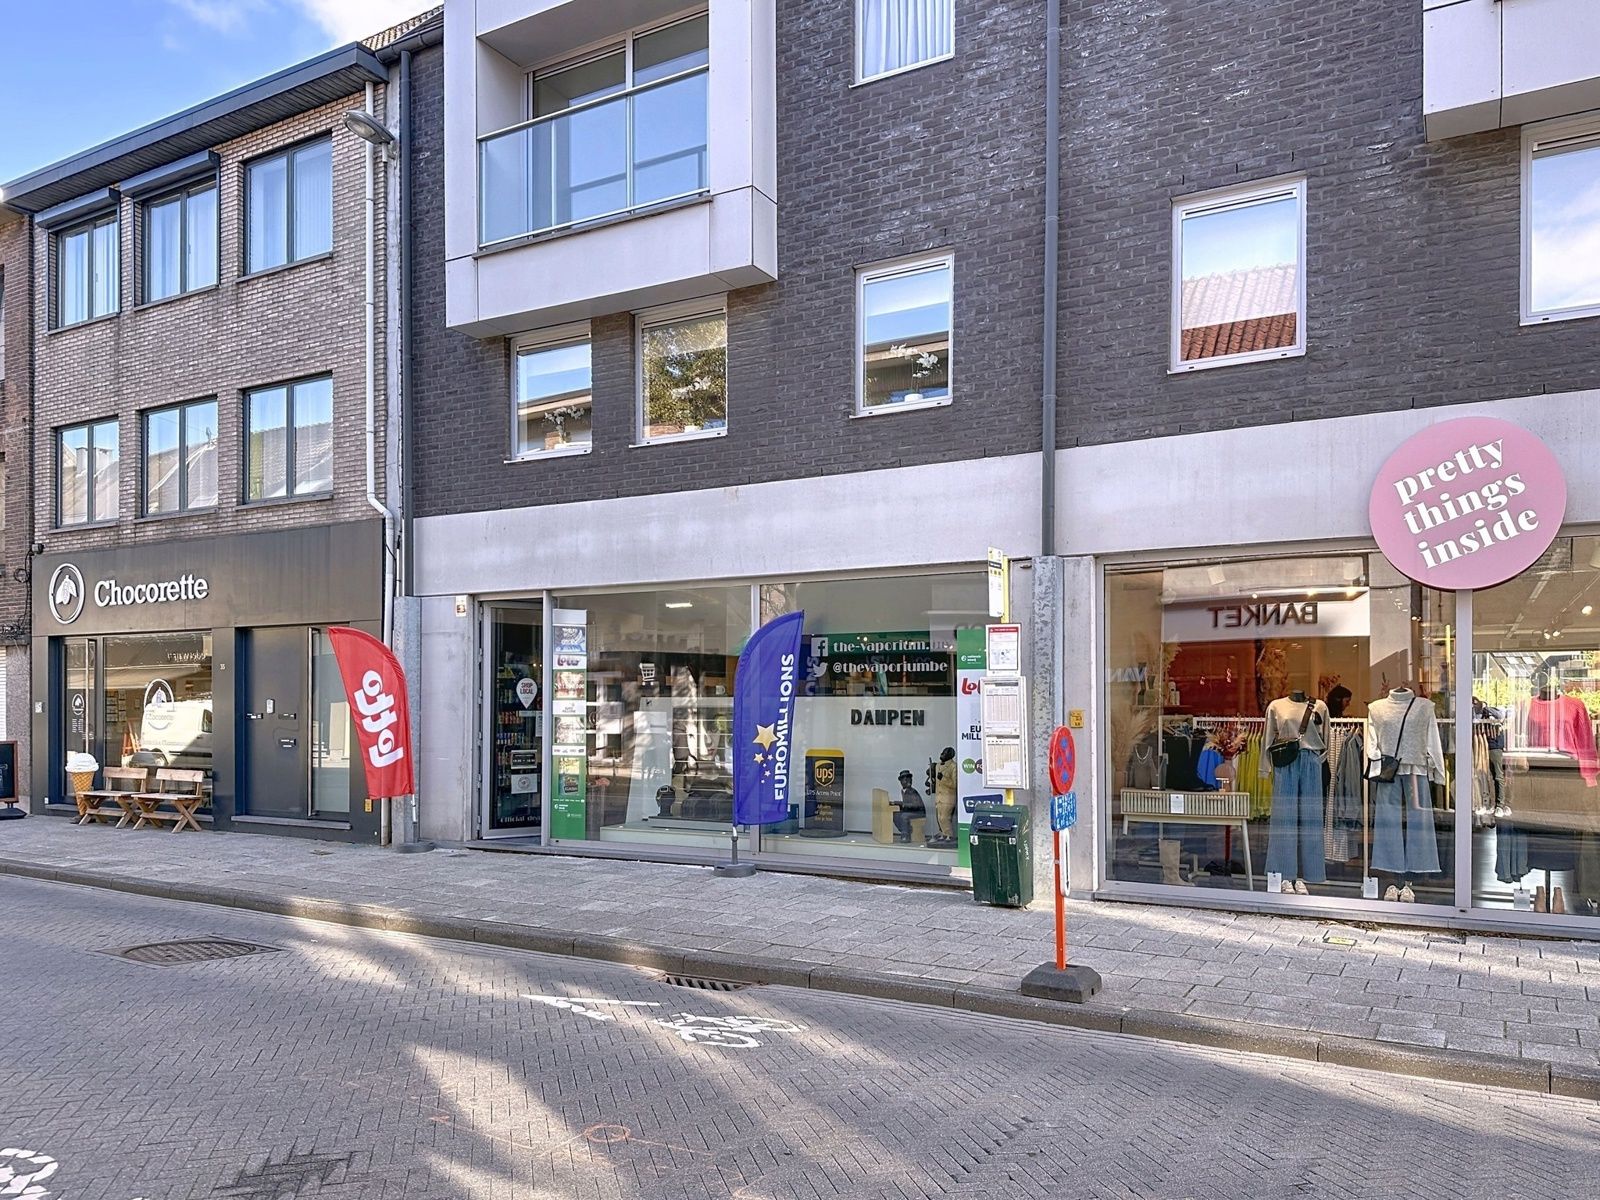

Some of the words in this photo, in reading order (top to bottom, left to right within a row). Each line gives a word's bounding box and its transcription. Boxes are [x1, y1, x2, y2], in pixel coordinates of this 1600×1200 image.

[1393, 438, 1504, 506] pretty
[1403, 472, 1527, 536] things
[1417, 509, 1540, 569] inside
[94, 573, 209, 608] Chocorette
[832, 660, 948, 673] @thevaporiumbe
[774, 653, 794, 801] EUROMILLIONS
[850, 709, 925, 726] DAMPEN
[816, 768, 833, 783] ups
